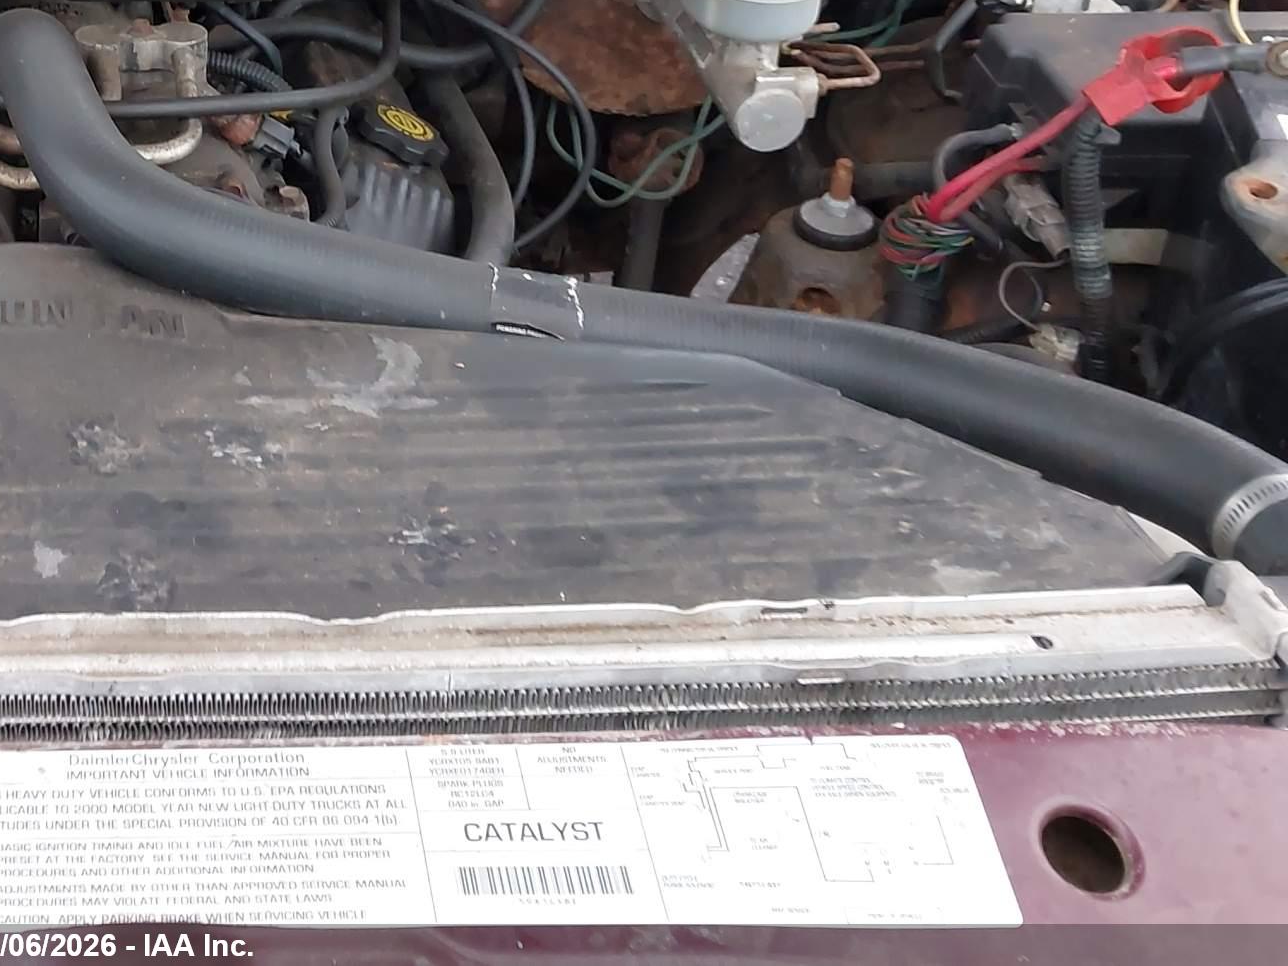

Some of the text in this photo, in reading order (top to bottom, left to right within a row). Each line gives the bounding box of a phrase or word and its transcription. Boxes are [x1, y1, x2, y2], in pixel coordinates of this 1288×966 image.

[68, 752, 305, 768] DaimlerChrysler Corporation
[67, 766, 310, 780] IMPORTANT VEHICLE INFORMATION
[6, 789, 47, 800] HEAVY
[52, 789, 85, 799] DUTY
[89, 788, 140, 799] VEHICLE
[144, 787, 216, 798] CONFORMS
[222, 786, 238, 797] TO
[270, 786, 295, 796] EPA
[299, 784, 386, 796] REGULATIONS
[55, 804, 69, 814] TO
[112, 803, 156, 813] MODEL
[272, 801, 306, 811] DUTY
[311, 800, 361, 810] TRUCKS
[365, 800, 380, 810] AT
[386, 799, 407, 809] ALL
[45, 819, 90, 830] UNDER
[96, 819, 118, 829] THE
[123, 818, 174, 829] SPECIAL
[179, 818, 247, 828] PROVISION
[251, 817, 266, 827] OF
[272, 817, 288, 827] 40
[464, 822, 604, 842] CATALYST
[138, 841, 164, 850] AND
[259, 851, 312, 861] MANUAL
[81, 867, 108, 877] AND
[82, 896, 109, 906] MAY
